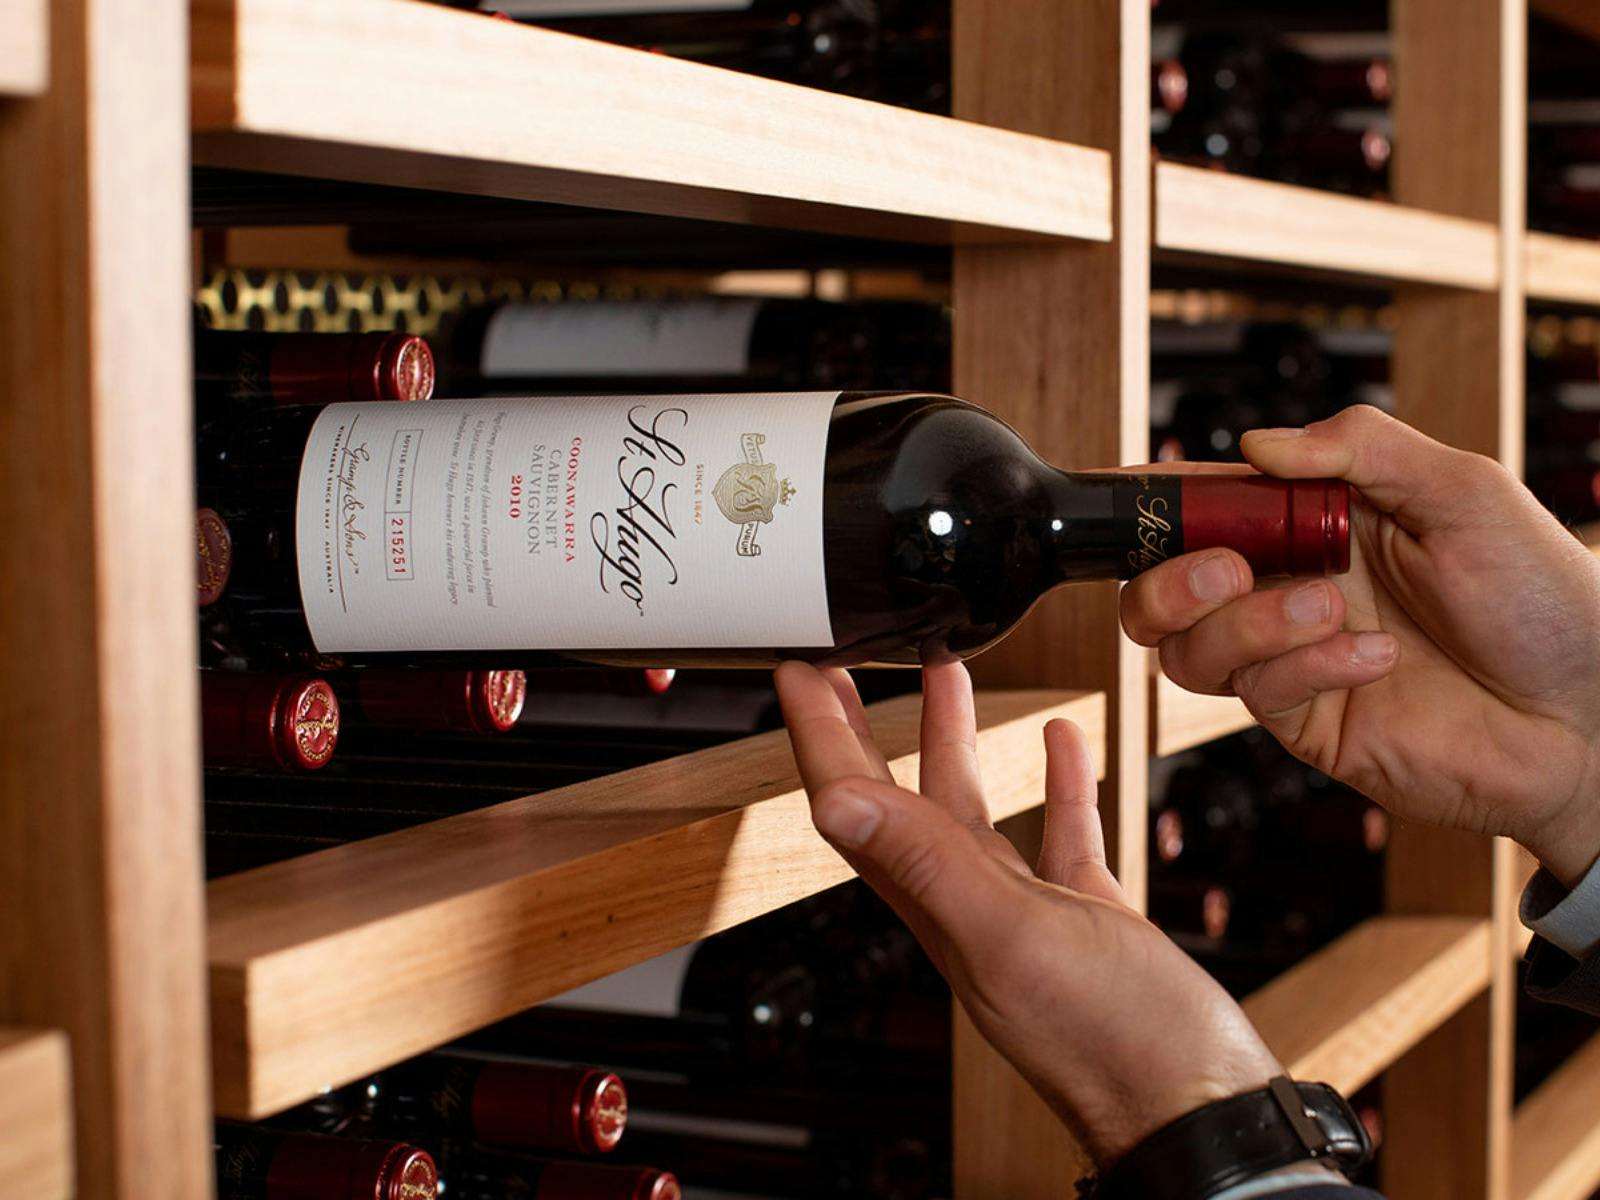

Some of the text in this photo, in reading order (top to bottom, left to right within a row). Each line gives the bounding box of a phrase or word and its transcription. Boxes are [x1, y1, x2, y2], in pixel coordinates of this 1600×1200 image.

[337, 442, 370, 492] Gramp
[395, 434, 412, 505] BOTTLE NUMBER
[445, 470, 458, 492] Hugo
[448, 461, 459, 471] St
[483, 449, 495, 483] grandson
[694, 464, 704, 496] SINCE
[324, 477, 333, 504] SINCE
[464, 472, 475, 494] 1847,
[481, 484, 492, 494] of
[509, 474, 524, 519] 2010
[527, 444, 546, 555] SAUVIGNON
[545, 449, 562, 548] CABERNET
[564, 436, 582, 563] COONAWARRA
[343, 494, 365, 515] &
[446, 493, 456, 526] honours
[463, 495, 471, 513] was
[481, 494, 491, 525] Johann
[589, 404, 689, 610] St Hugo
[1136, 495, 1171, 531] St
[392, 518, 406, 574] 215251
[446, 528, 456, 540] his
[461, 521, 474, 562] powerful
[480, 527, 491, 557] Gramp
[741, 523, 755, 554] PURUM
[1127, 526, 1168, 572] Hug
[324, 541, 335, 594] AUSTRALIA
[445, 542, 456, 580] enduring
[463, 562, 474, 583] force
[467, 584, 477, 594] in
